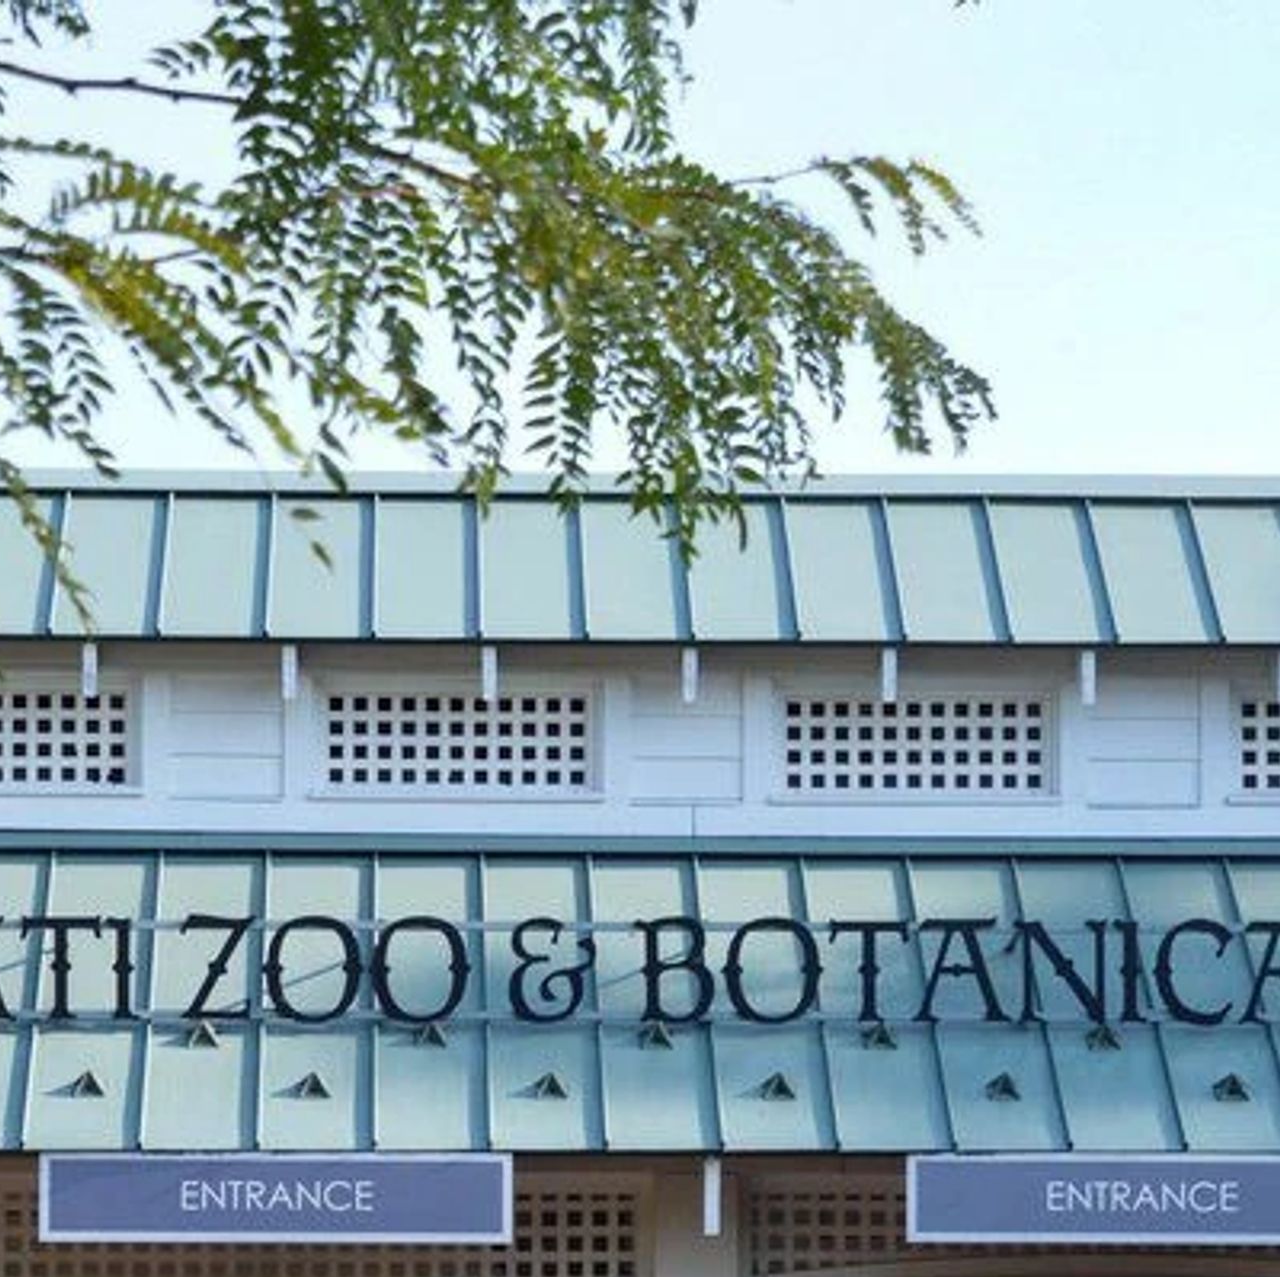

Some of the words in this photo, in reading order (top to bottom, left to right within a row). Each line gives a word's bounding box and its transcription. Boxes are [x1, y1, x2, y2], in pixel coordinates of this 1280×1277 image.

[180, 914, 472, 1024] ZOO
[508, 917, 597, 1022] &
[180, 1179, 374, 1211] ENTRANCE
[1045, 1179, 1240, 1212] ENTRANCE
